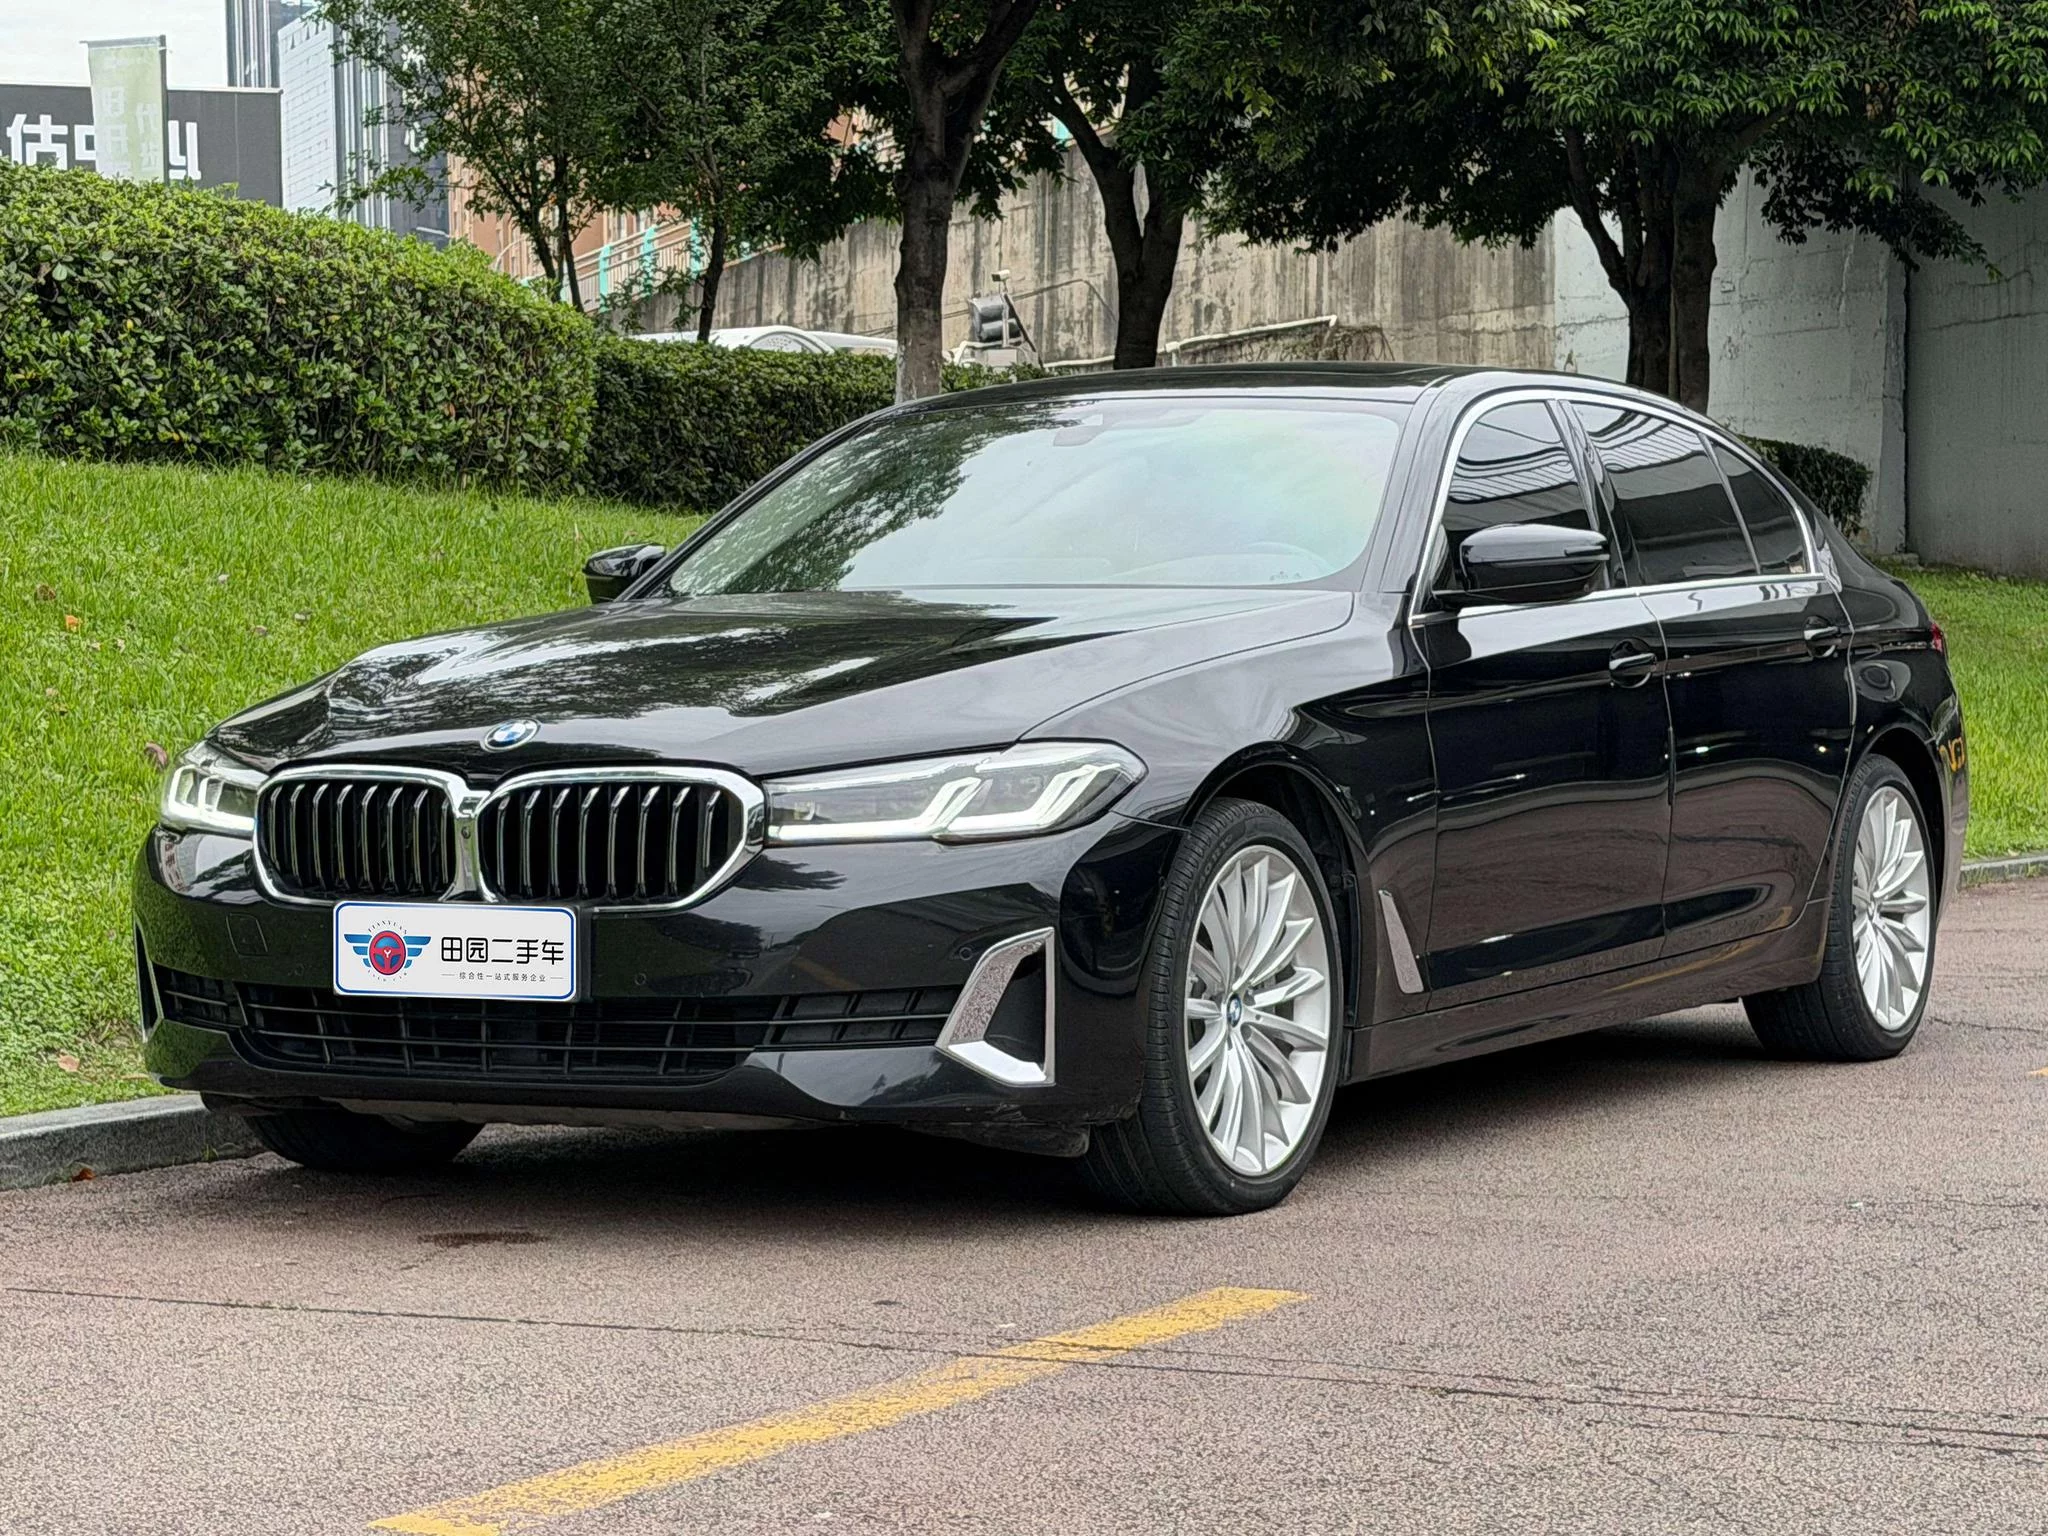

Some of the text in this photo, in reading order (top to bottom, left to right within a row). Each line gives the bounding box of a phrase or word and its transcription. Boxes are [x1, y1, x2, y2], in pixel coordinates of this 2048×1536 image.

[441, 936, 564, 965] 田园二手车
[459, 971, 546, 982] 综合性一站式服务企业
